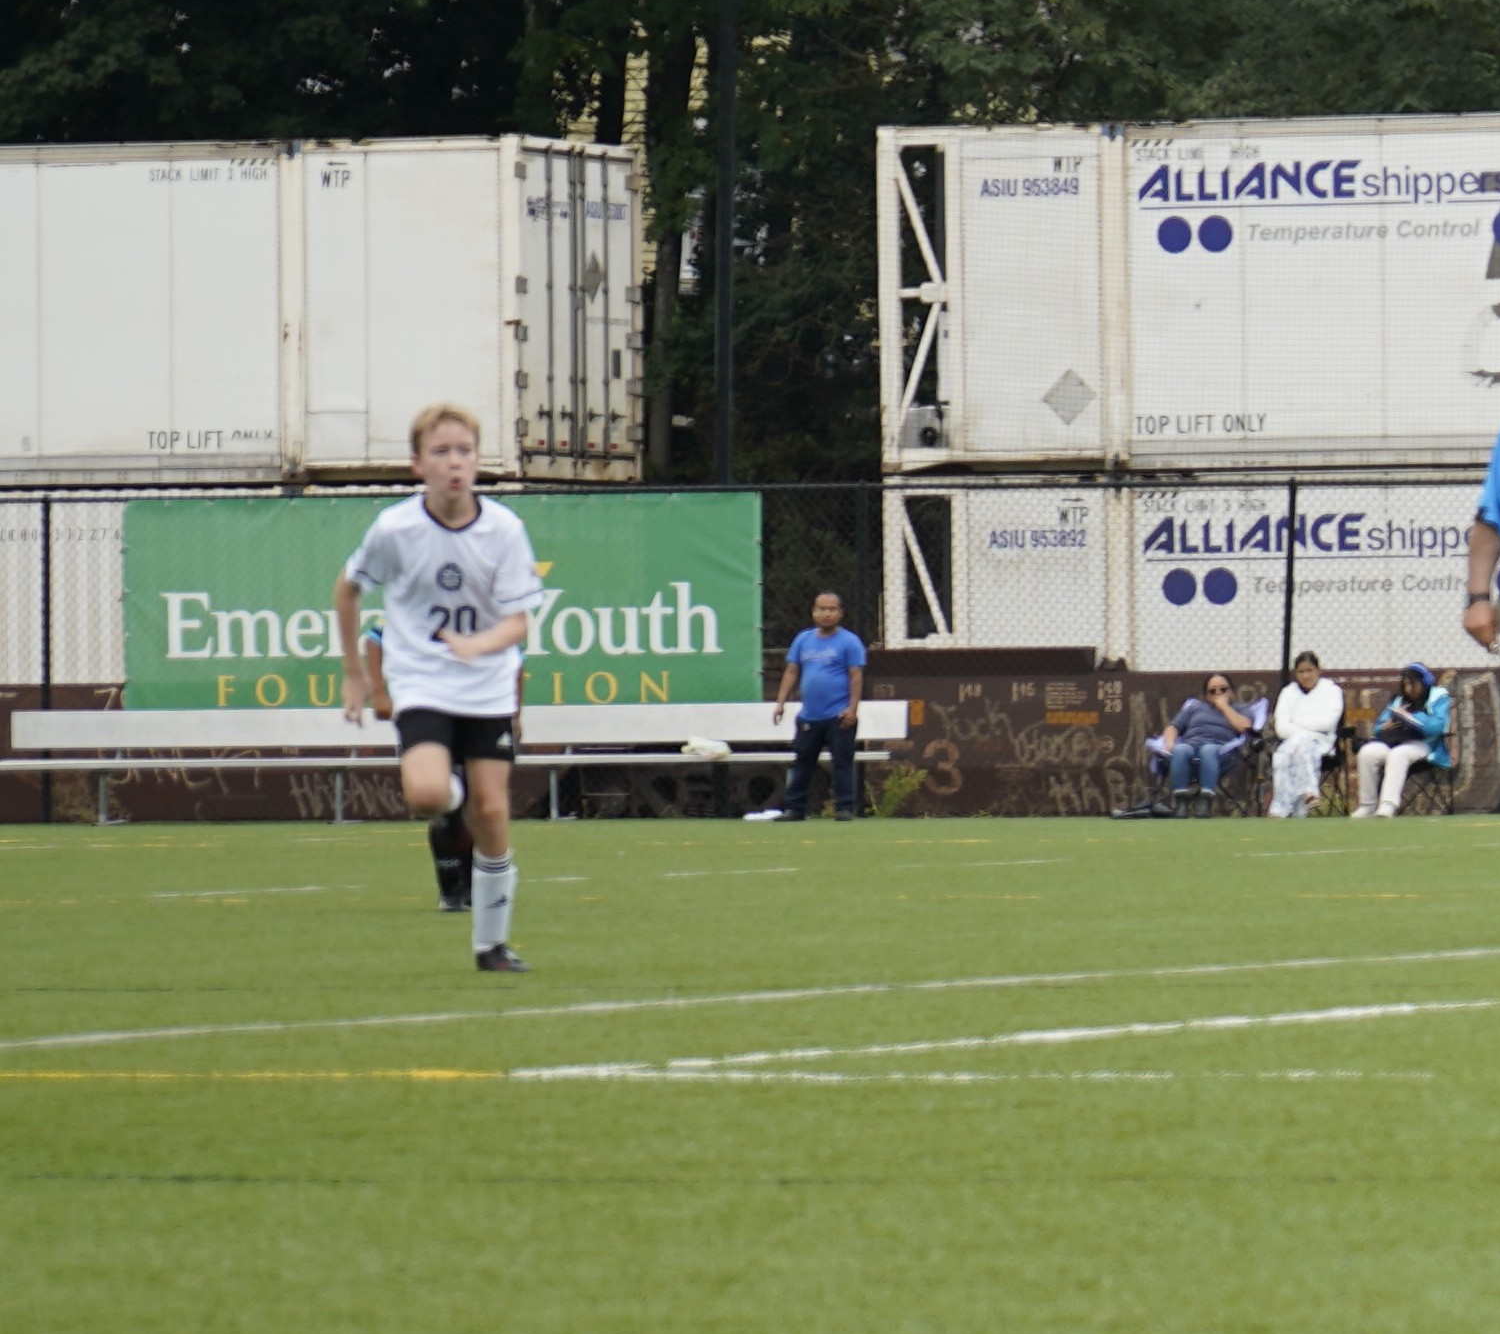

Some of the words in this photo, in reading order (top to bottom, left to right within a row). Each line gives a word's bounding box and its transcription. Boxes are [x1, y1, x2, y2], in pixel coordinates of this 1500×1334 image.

[148, 167, 183, 183] STACK
[189, 167, 220, 182] LIMIT
[240, 166, 268, 182] HIGH
[320, 170, 351, 189] WTP
[1138, 159, 1363, 203] ALLIANCE
[980, 178, 1018, 197] ASIU
[1022, 177, 1080, 196] 953849
[1247, 220, 1389, 245] Temperature
[1397, 218, 1481, 239] Control
[1135, 415, 1170, 436] TOP
[1176, 414, 1215, 435] LIFT
[1222, 413, 1267, 434] ONLY
[147, 431, 180, 451] TOP
[187, 430, 223, 450] LIFT
[988, 530, 1025, 550] ASIU
[1142, 513, 1367, 555] ALLIANCE
[427, 605, 477, 644] 20
[524, 581, 723, 657] Youth
